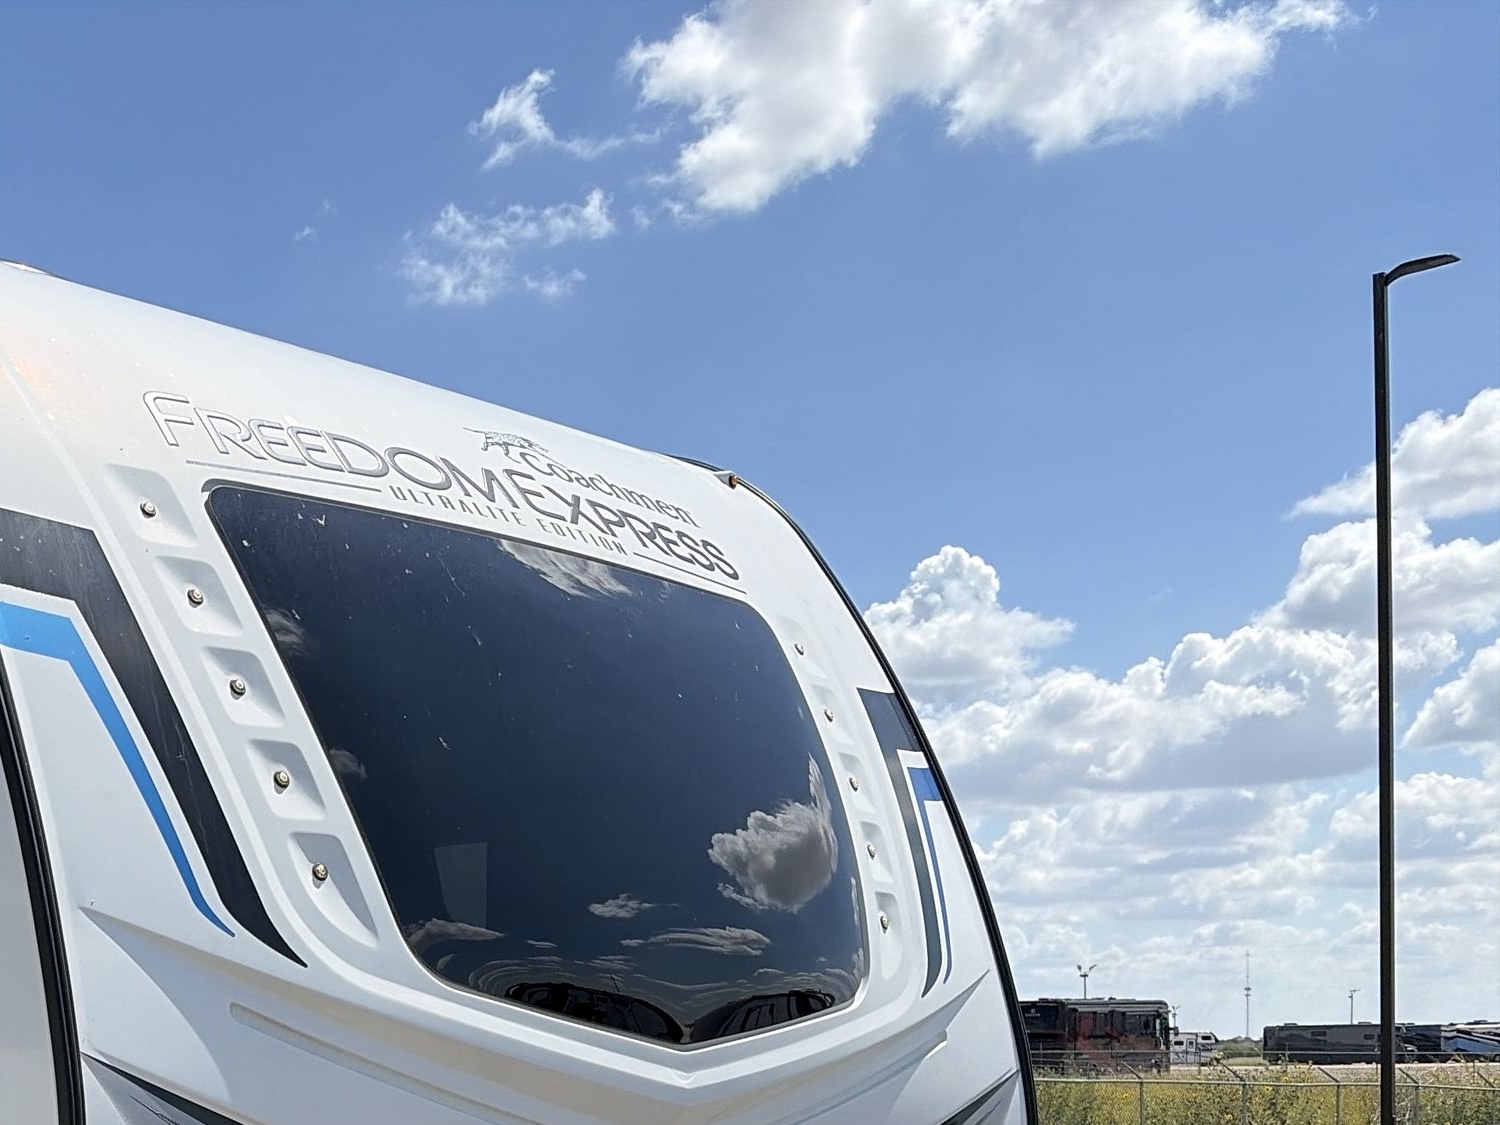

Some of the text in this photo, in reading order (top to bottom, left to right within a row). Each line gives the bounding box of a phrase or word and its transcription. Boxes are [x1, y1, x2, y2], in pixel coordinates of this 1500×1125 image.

[389, 484, 628, 555] ULTRALITE EDITION
[519, 451, 700, 529] Coachmen
